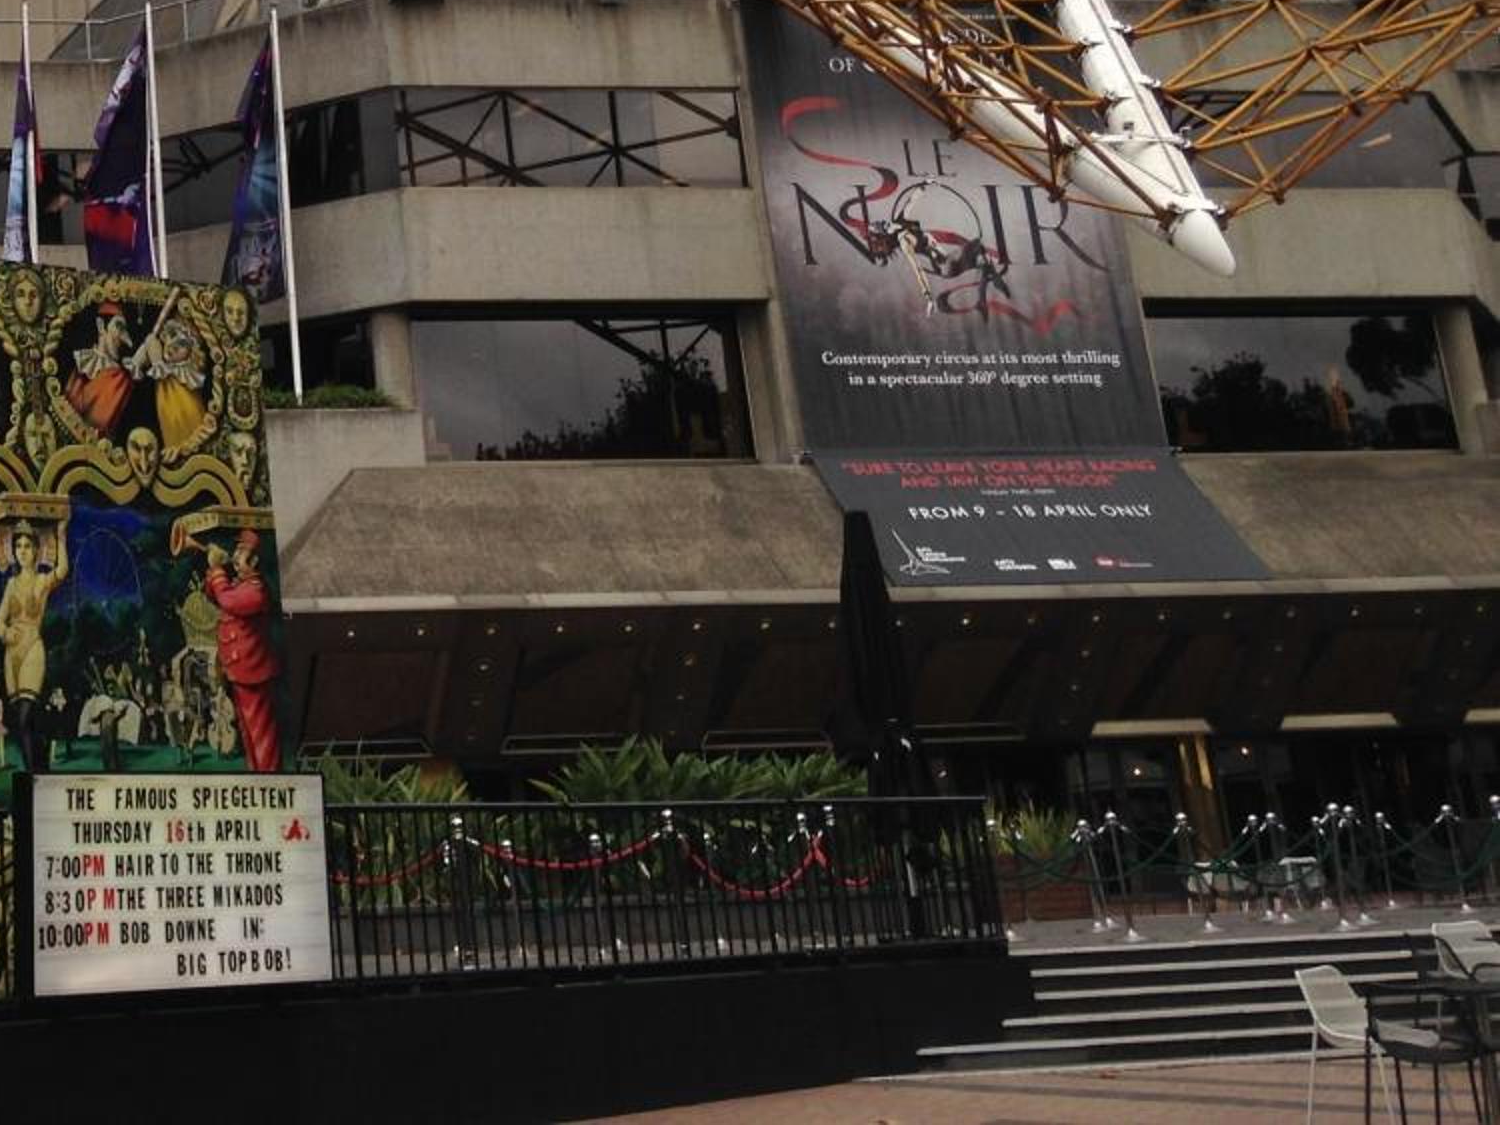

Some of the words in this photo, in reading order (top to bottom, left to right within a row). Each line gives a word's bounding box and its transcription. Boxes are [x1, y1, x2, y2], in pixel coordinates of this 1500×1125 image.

[829, 57, 855, 73] OF
[902, 138, 957, 177] LE
[822, 351, 930, 368] Contemporary
[935, 351, 978, 365] circus
[982, 352, 995, 365] at
[1001, 351, 1017, 364] its
[1022, 353, 1057, 365] most
[1061, 350, 1120, 367] thrilling
[849, 372, 863, 386] in
[867, 376, 875, 385] a
[879, 372, 963, 387] spectacular
[1000, 372, 1048, 387] degree
[1052, 372, 1102, 387] setting
[908, 506, 969, 520] FROM
[973, 505, 986, 518] 9
[1012, 505, 1037, 518] 18
[1043, 504, 1097, 518] APRIL
[1100, 503, 1152, 518] ONLY
[66, 788, 94, 810] THE
[116, 788, 177, 810] FAMOUS
[193, 786, 296, 809] SPIEGELTENT
[73, 821, 151, 844] THURSDAY
[166, 822, 205, 844] 16th
[215, 820, 261, 841] APRIL
[46, 852, 105, 878] 7:00PM
[116, 853, 154, 875] HAIR
[160, 853, 179, 874] TO
[187, 852, 213, 874] THE
[226, 851, 282, 873] THRONE
[156, 886, 204, 908] THREE
[213, 883, 283, 907] MIKADOS
[120, 922, 150, 944] BOB
[165, 919, 216, 942] DOWNE
[177, 953, 207, 976] BIG
